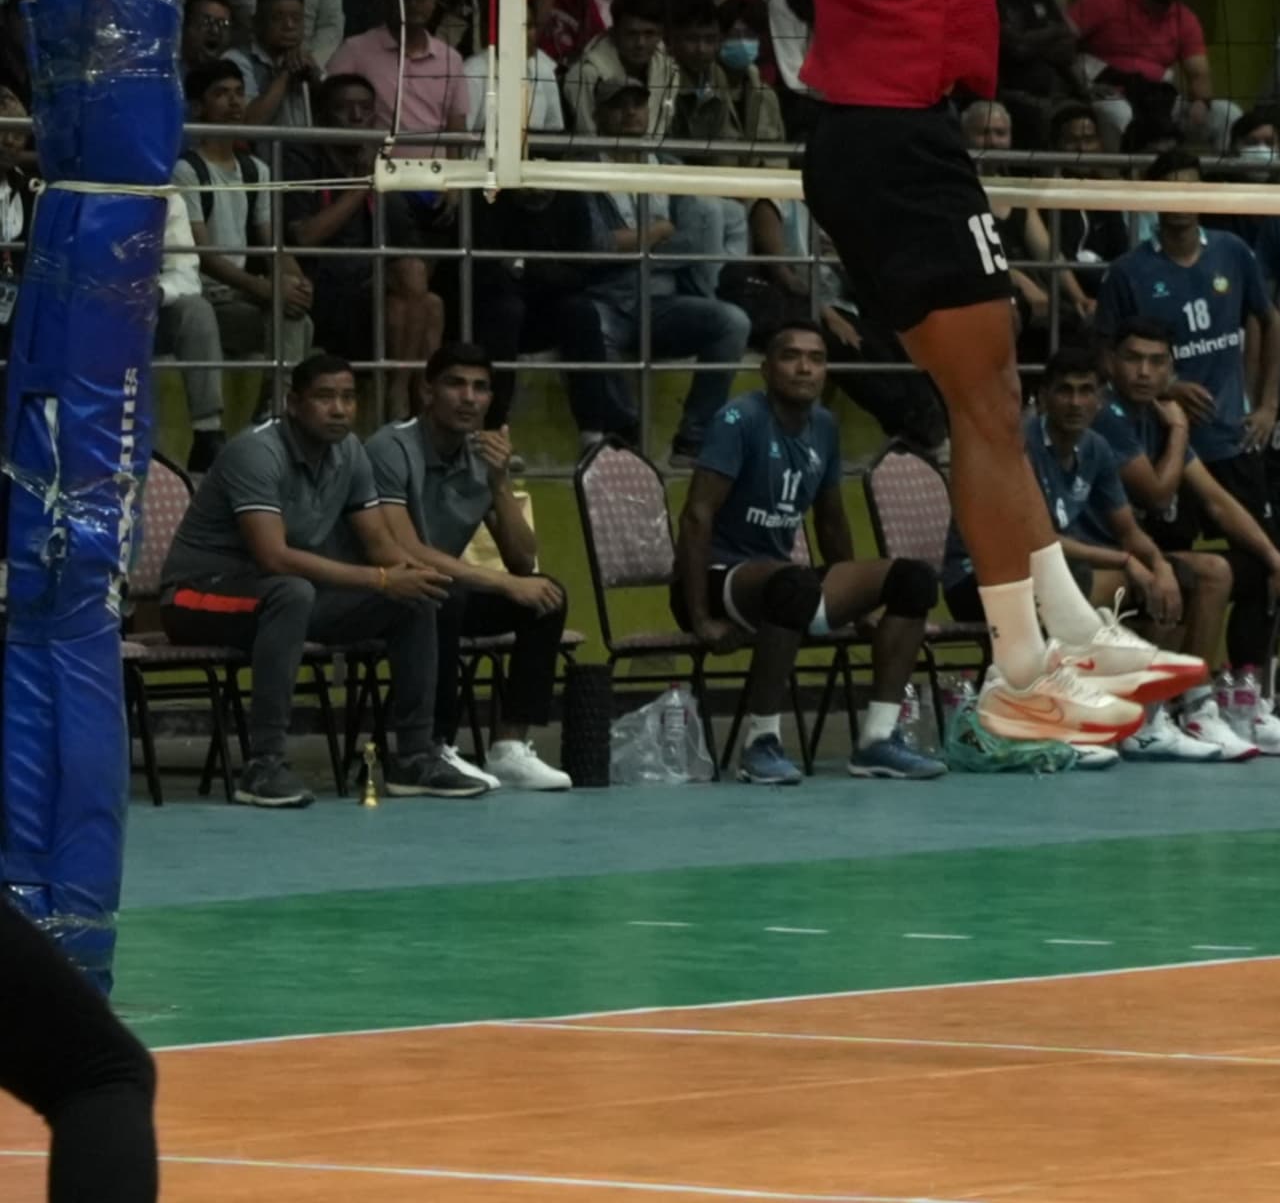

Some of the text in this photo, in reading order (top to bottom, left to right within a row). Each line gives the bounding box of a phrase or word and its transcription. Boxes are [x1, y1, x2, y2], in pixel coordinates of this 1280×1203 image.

[968, 212, 1009, 275] 15
[1182, 297, 1211, 333] 18
[781, 468, 802, 501] 11
